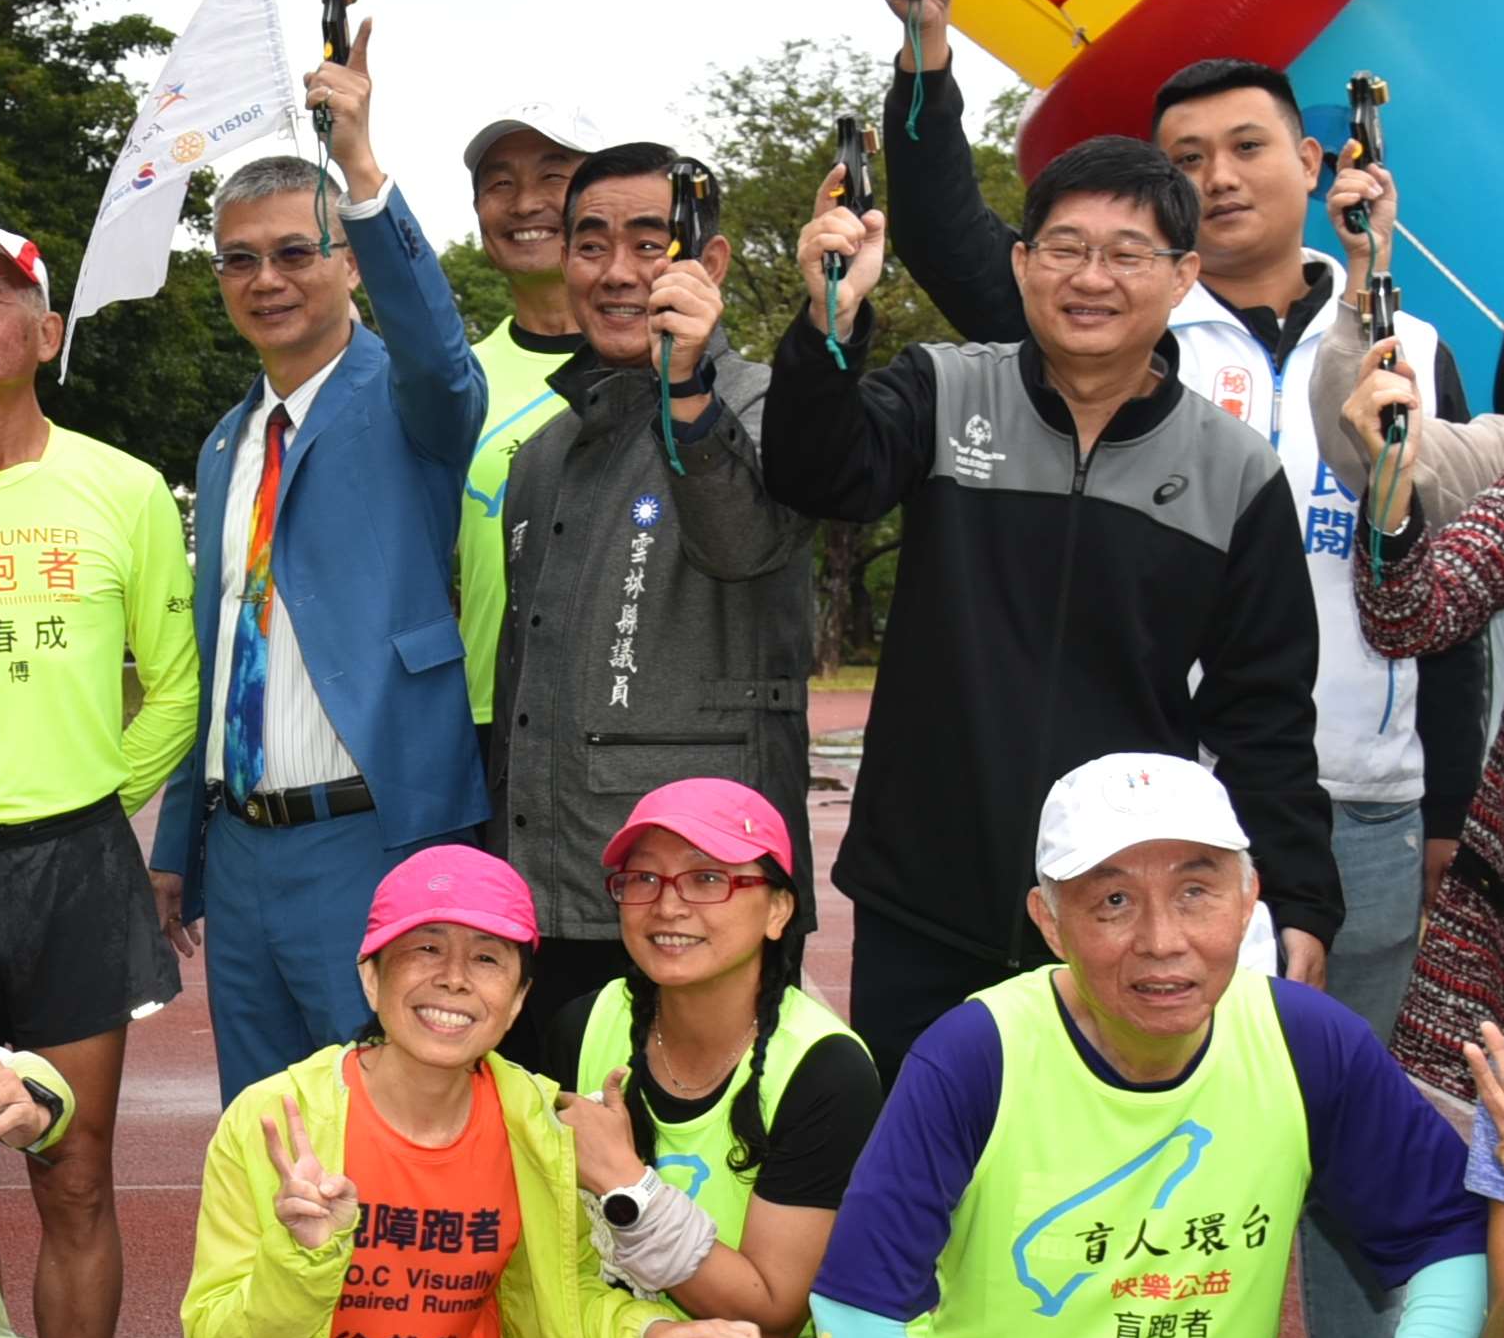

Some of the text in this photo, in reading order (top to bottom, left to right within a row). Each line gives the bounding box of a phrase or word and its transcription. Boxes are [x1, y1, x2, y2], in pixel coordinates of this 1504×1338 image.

[608, 532, 655, 708] 雲林縣議員
[1075, 1204, 1270, 1265] 盲人環台
[1110, 1268, 1232, 1301] 快樂公益
